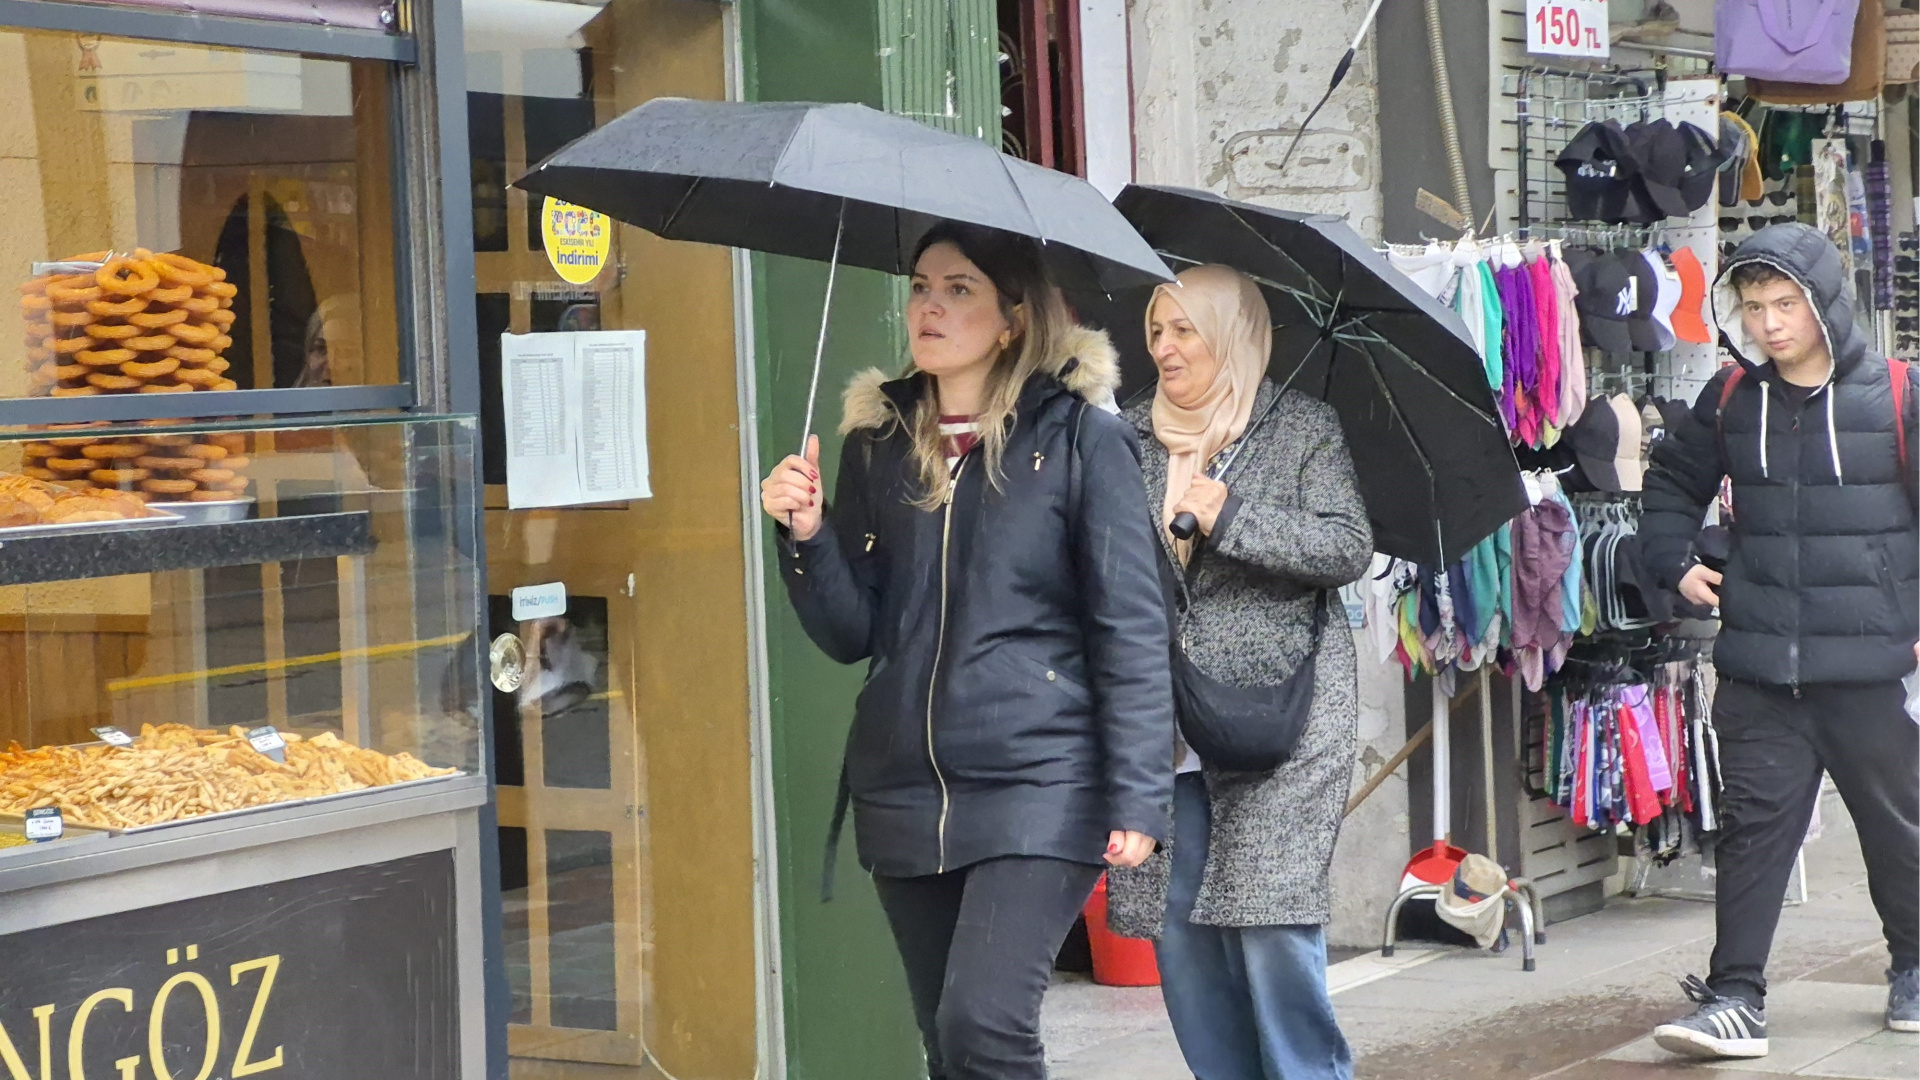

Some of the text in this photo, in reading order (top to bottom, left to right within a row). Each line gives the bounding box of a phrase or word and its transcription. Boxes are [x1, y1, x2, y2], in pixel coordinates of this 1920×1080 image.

[1535, 6, 1602, 48] 150 TL
[551, 209, 601, 237] 2025
